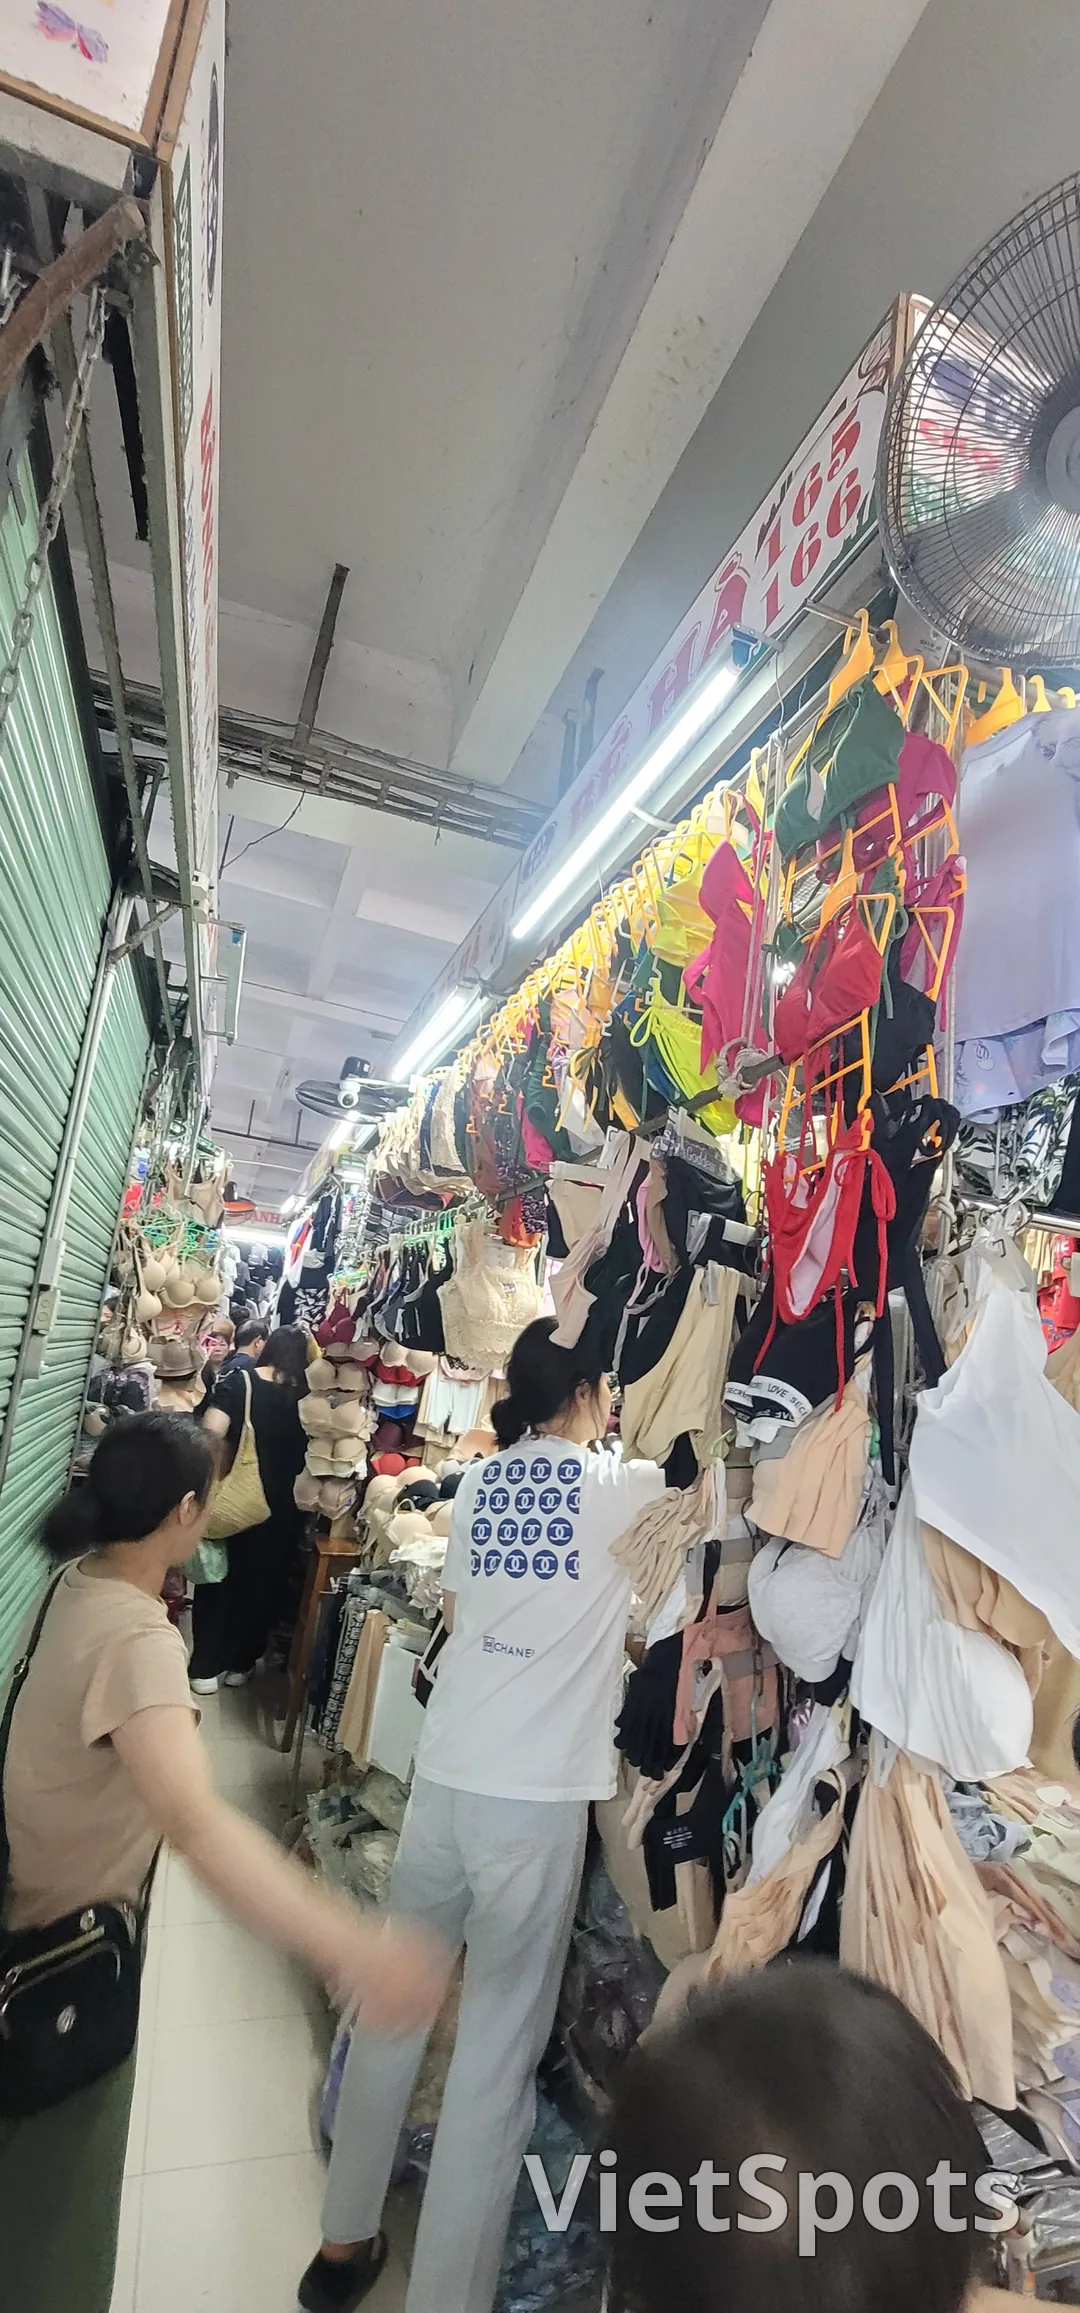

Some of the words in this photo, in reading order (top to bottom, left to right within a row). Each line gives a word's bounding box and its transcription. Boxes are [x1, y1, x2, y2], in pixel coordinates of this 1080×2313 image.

[761, 468, 861, 633] 166
[762, 400, 861, 580] 165
[767, 1383, 789, 1398] LOVE
